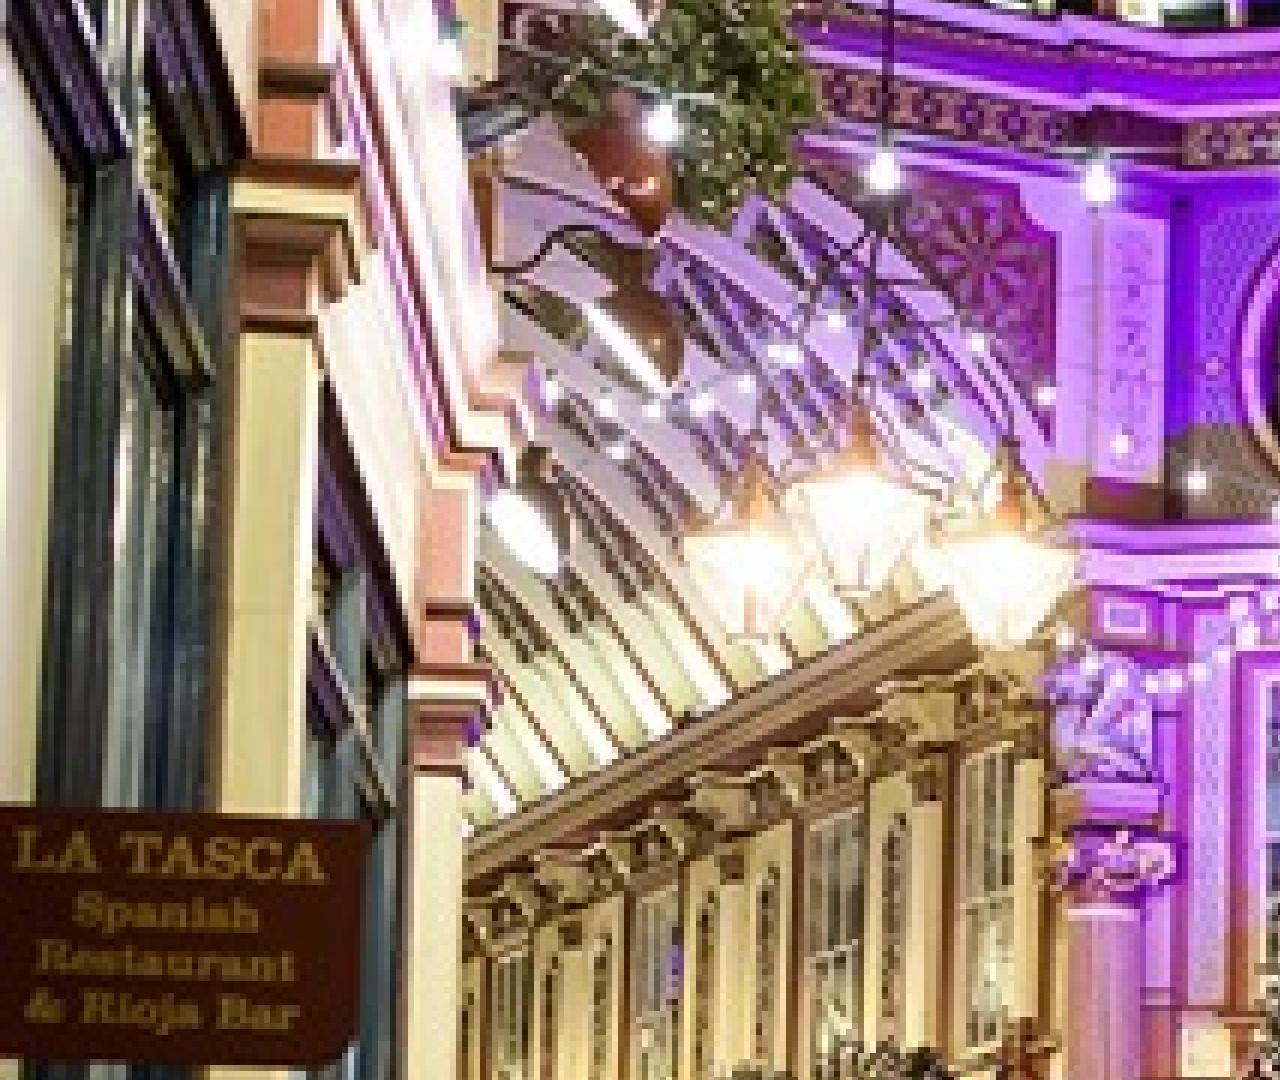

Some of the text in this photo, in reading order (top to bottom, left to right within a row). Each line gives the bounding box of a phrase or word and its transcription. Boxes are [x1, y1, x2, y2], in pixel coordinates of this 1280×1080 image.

[14, 828, 329, 884] LA TASCA
[75, 891, 259, 934] Spanish
[38, 939, 296, 982] Restaurant
[28, 988, 301, 1035] & Rioja Bar
